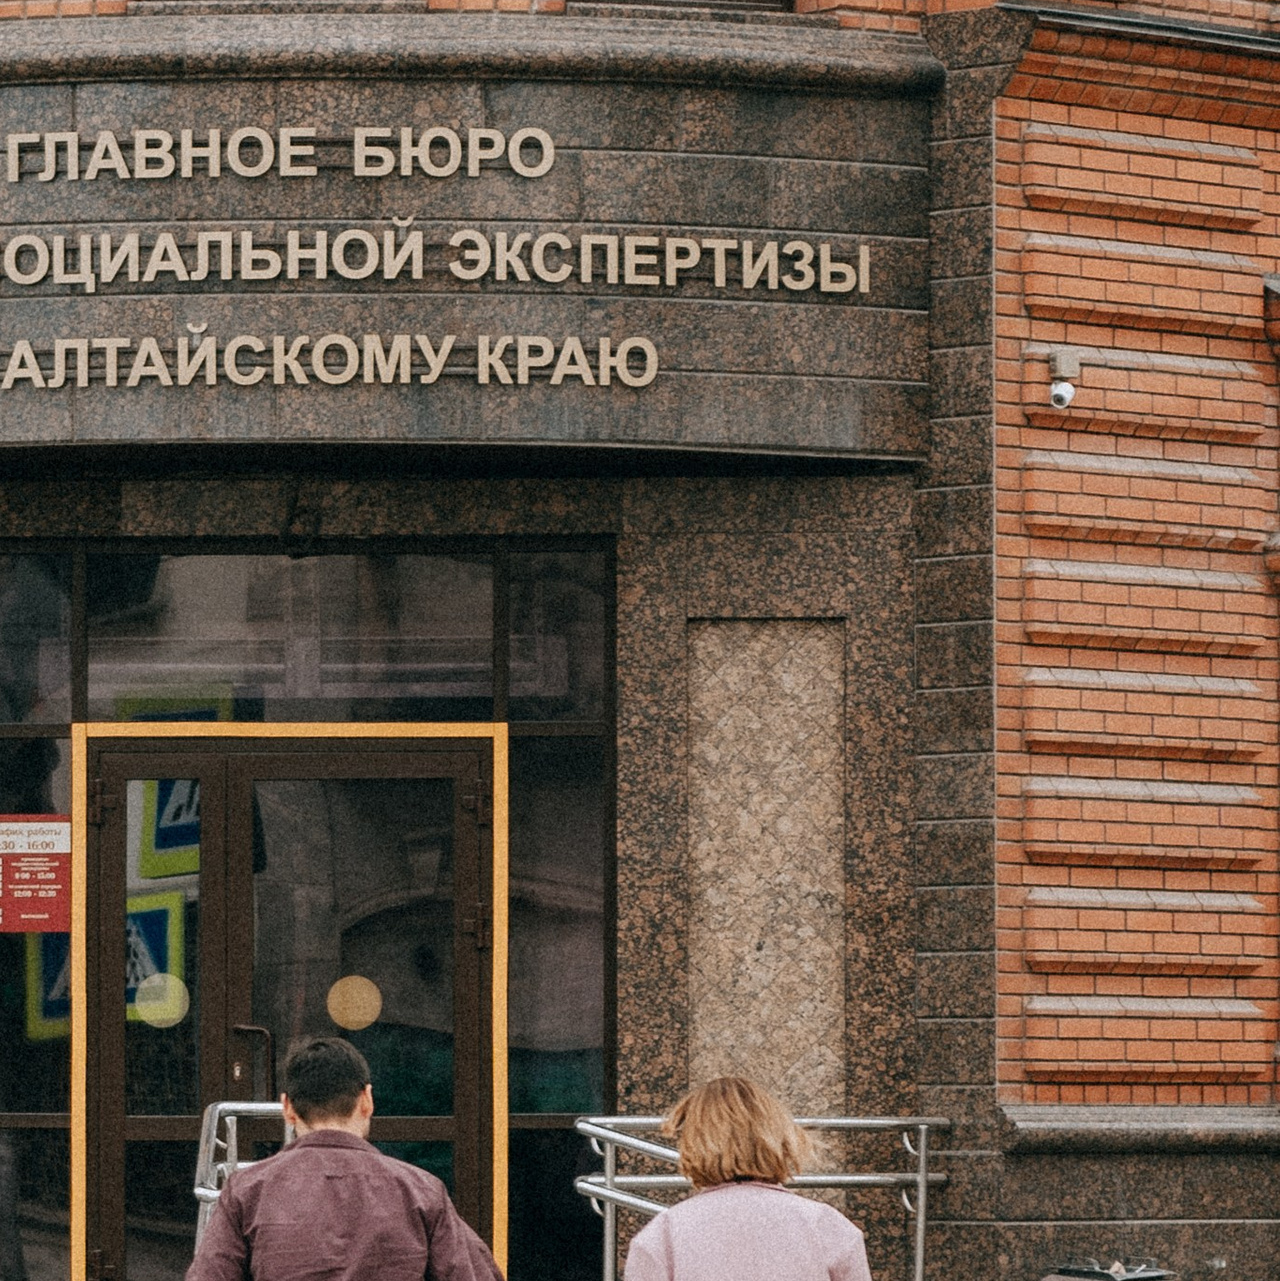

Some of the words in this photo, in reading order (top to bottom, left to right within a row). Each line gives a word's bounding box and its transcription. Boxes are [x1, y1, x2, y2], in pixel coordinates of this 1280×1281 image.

[6, 126, 318, 183] ГЛАВНОЕ
[353, 126, 556, 178] БЮРО
[448, 229, 871, 294] ЭКСПЕРТИЗЫ
[1, 322, 455, 389] АЛТАЙСКОМУ
[477, 334, 658, 388] КРАЮ
[27, 826, 62, 837] работы
